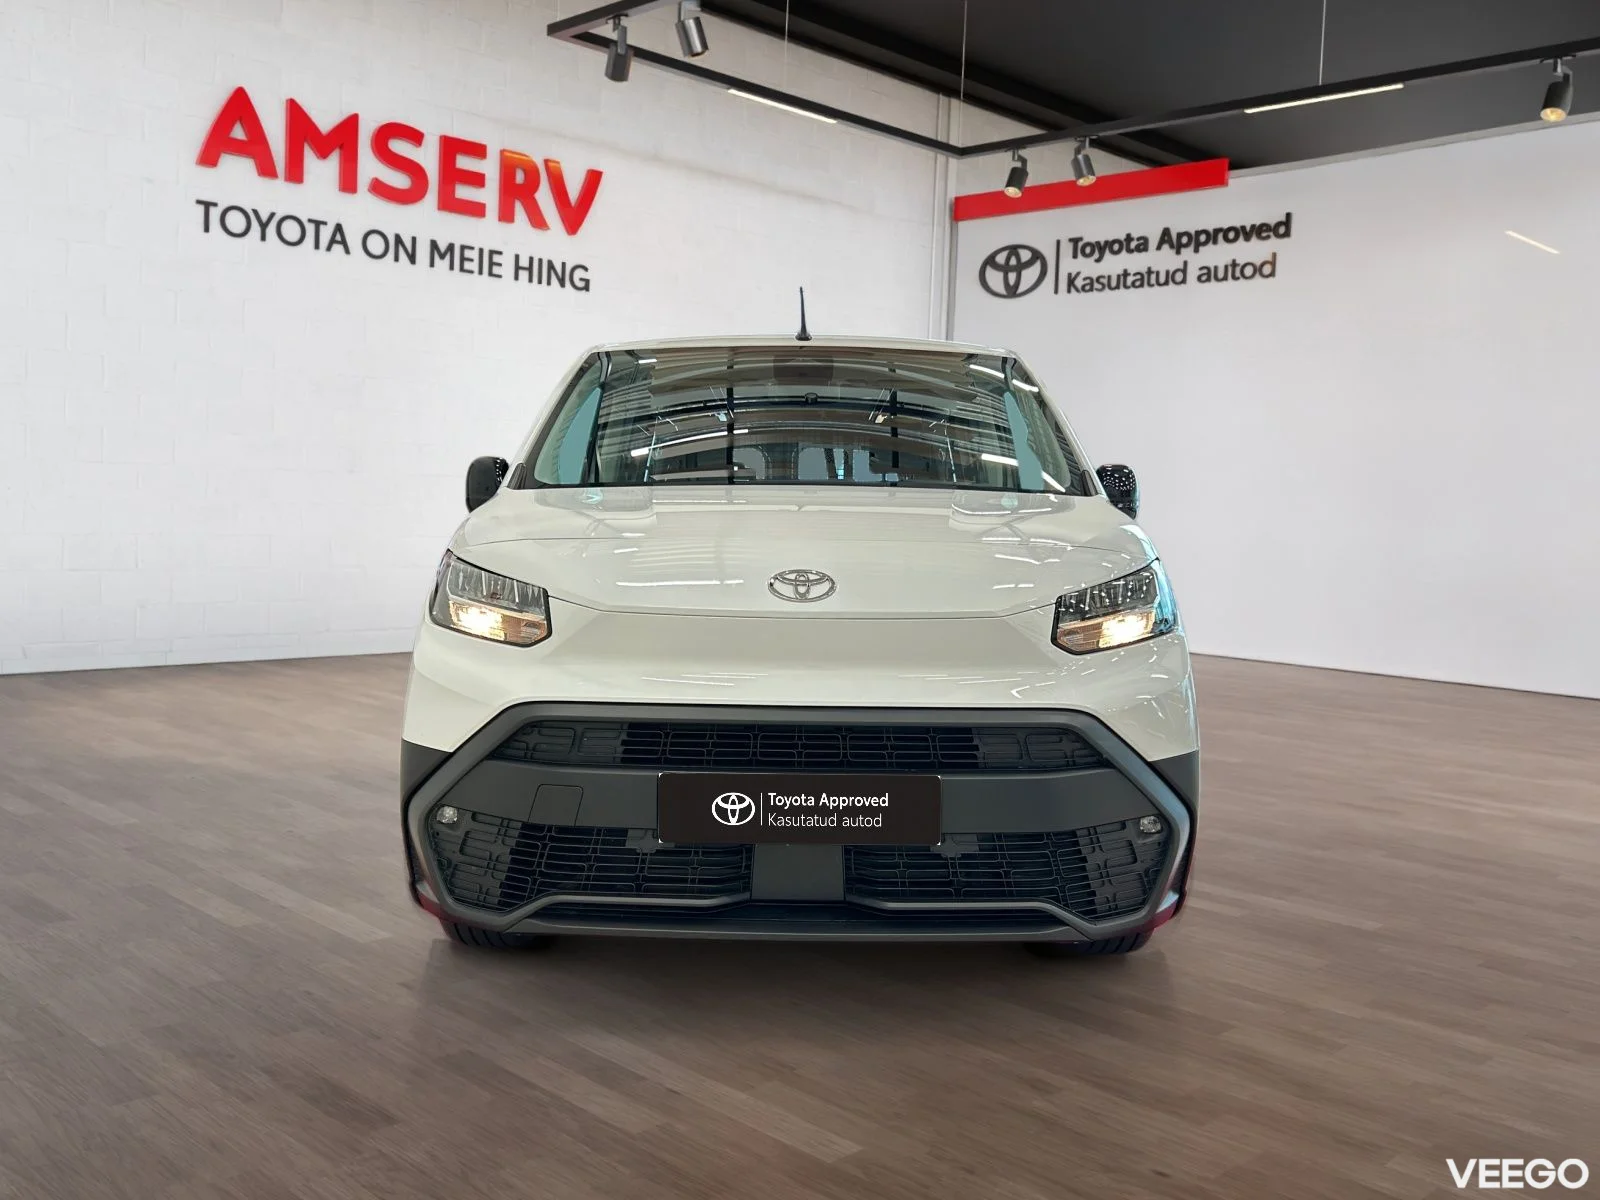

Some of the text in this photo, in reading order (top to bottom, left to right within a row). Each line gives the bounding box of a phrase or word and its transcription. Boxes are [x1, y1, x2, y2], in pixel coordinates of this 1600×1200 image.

[195, 86, 603, 236] AMSERV
[195, 199, 591, 292] TOYOTA ON MEIE HING
[1069, 212, 1292, 263] Toyota Approved
[1066, 252, 1277, 294] Kasutatud autod
[768, 792, 889, 810] Toyota Approved
[768, 813, 882, 827] Kasutatud autod
